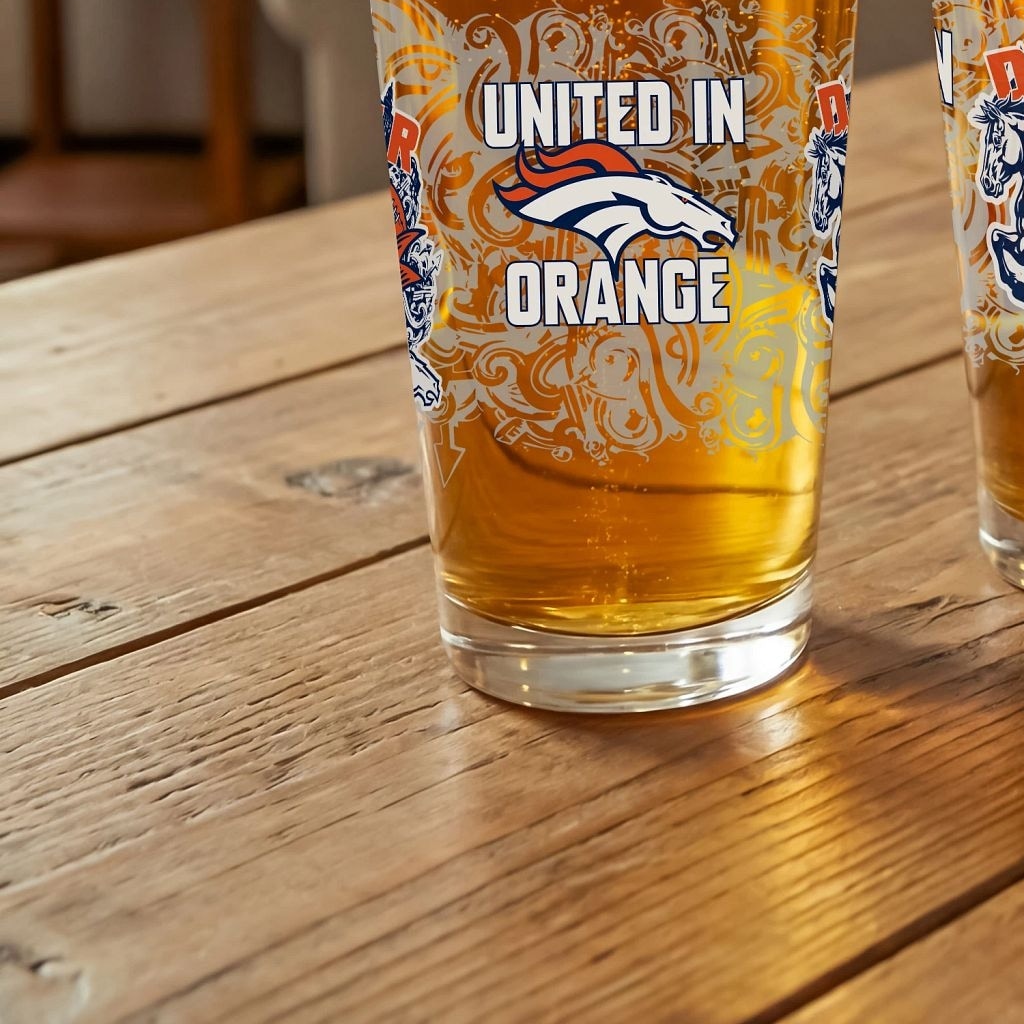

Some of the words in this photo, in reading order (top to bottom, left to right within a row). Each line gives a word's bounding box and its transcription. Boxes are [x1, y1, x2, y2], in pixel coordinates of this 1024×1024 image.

[483, 80, 672, 149] UNITED
[693, 77, 746, 145] IN
[504, 257, 730, 327] ORANGE
